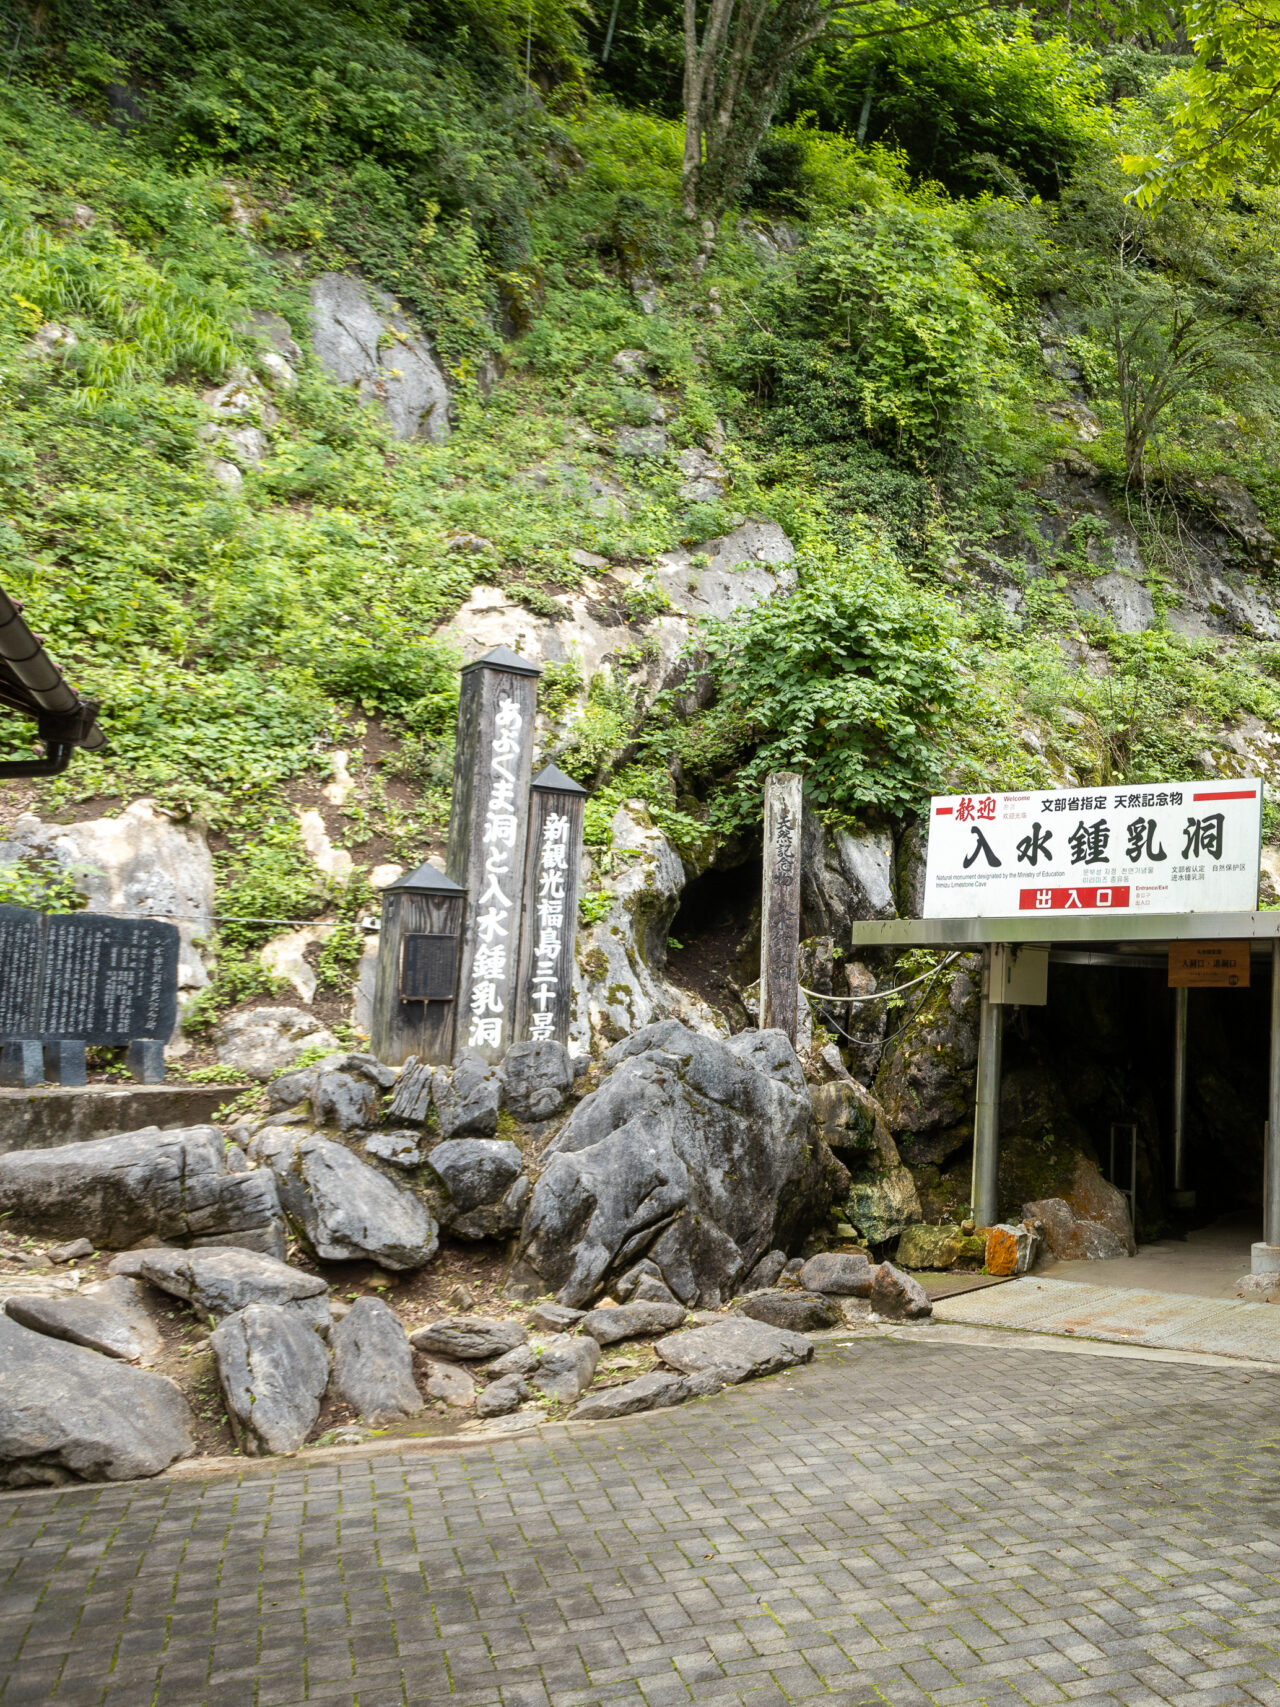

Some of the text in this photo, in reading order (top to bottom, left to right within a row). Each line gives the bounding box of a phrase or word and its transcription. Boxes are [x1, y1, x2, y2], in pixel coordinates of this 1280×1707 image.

[1041, 792, 1183, 813] 文部省指定 天然記念物
[774, 815, 795, 887] 天然記念物
[963, 813, 1225, 869] 入水鍾乳洞
[467, 698, 523, 1049] あぶくま洞と入水鍾乳洞
[977, 872, 1002, 881] designated
[1017, 871, 1035, 879] Ministry
[1035, 889, 1112, 909] 出入口
[528, 812, 570, 1041] 新観光福島三十景
